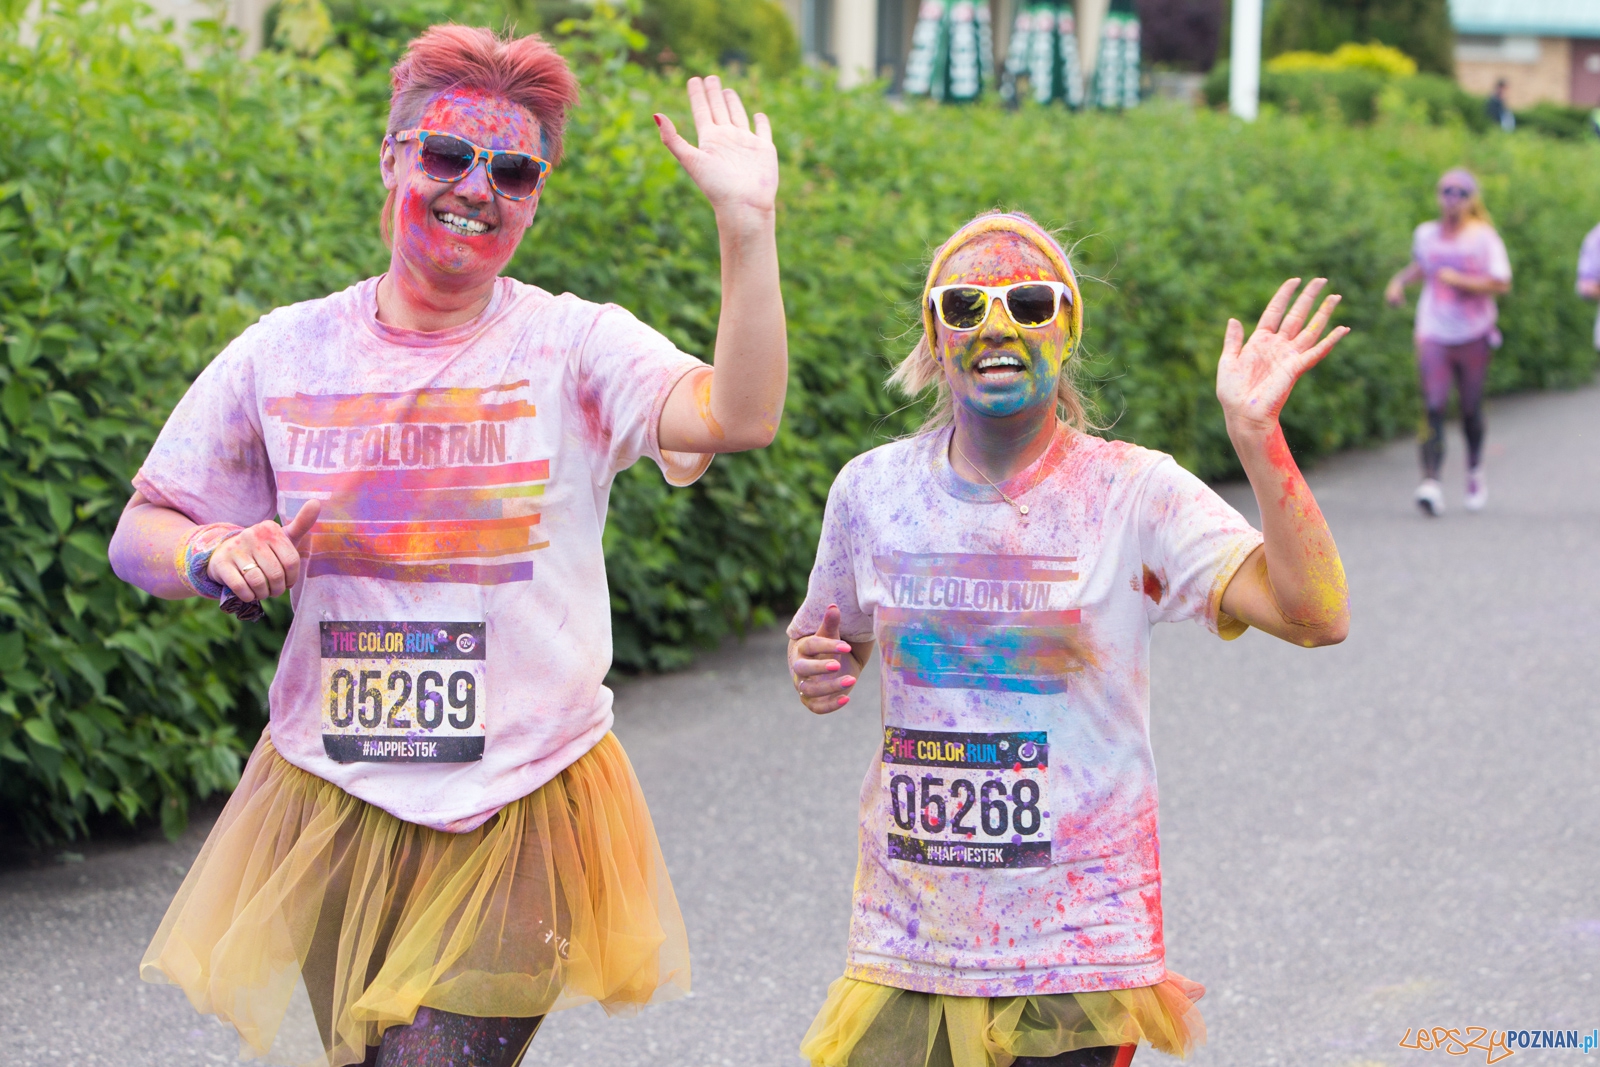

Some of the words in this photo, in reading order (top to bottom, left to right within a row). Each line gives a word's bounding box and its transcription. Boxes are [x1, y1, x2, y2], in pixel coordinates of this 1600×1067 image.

[286, 425, 337, 468] THE
[343, 424, 444, 467] COLOR
[448, 423, 506, 464] RUN
[888, 575, 924, 606] THE
[928, 577, 1004, 610] COLOR
[1007, 582, 1052, 611] RUN
[331, 631, 357, 652] THE
[358, 631, 403, 653] COLOR
[329, 669, 476, 730] 05269
[362, 741, 437, 758] #HAPPIEST5K
[892, 737, 916, 759] THE
[917, 740, 965, 762] COLOR
[967, 743, 997, 763] RUN
[890, 774, 1041, 837] 05268
